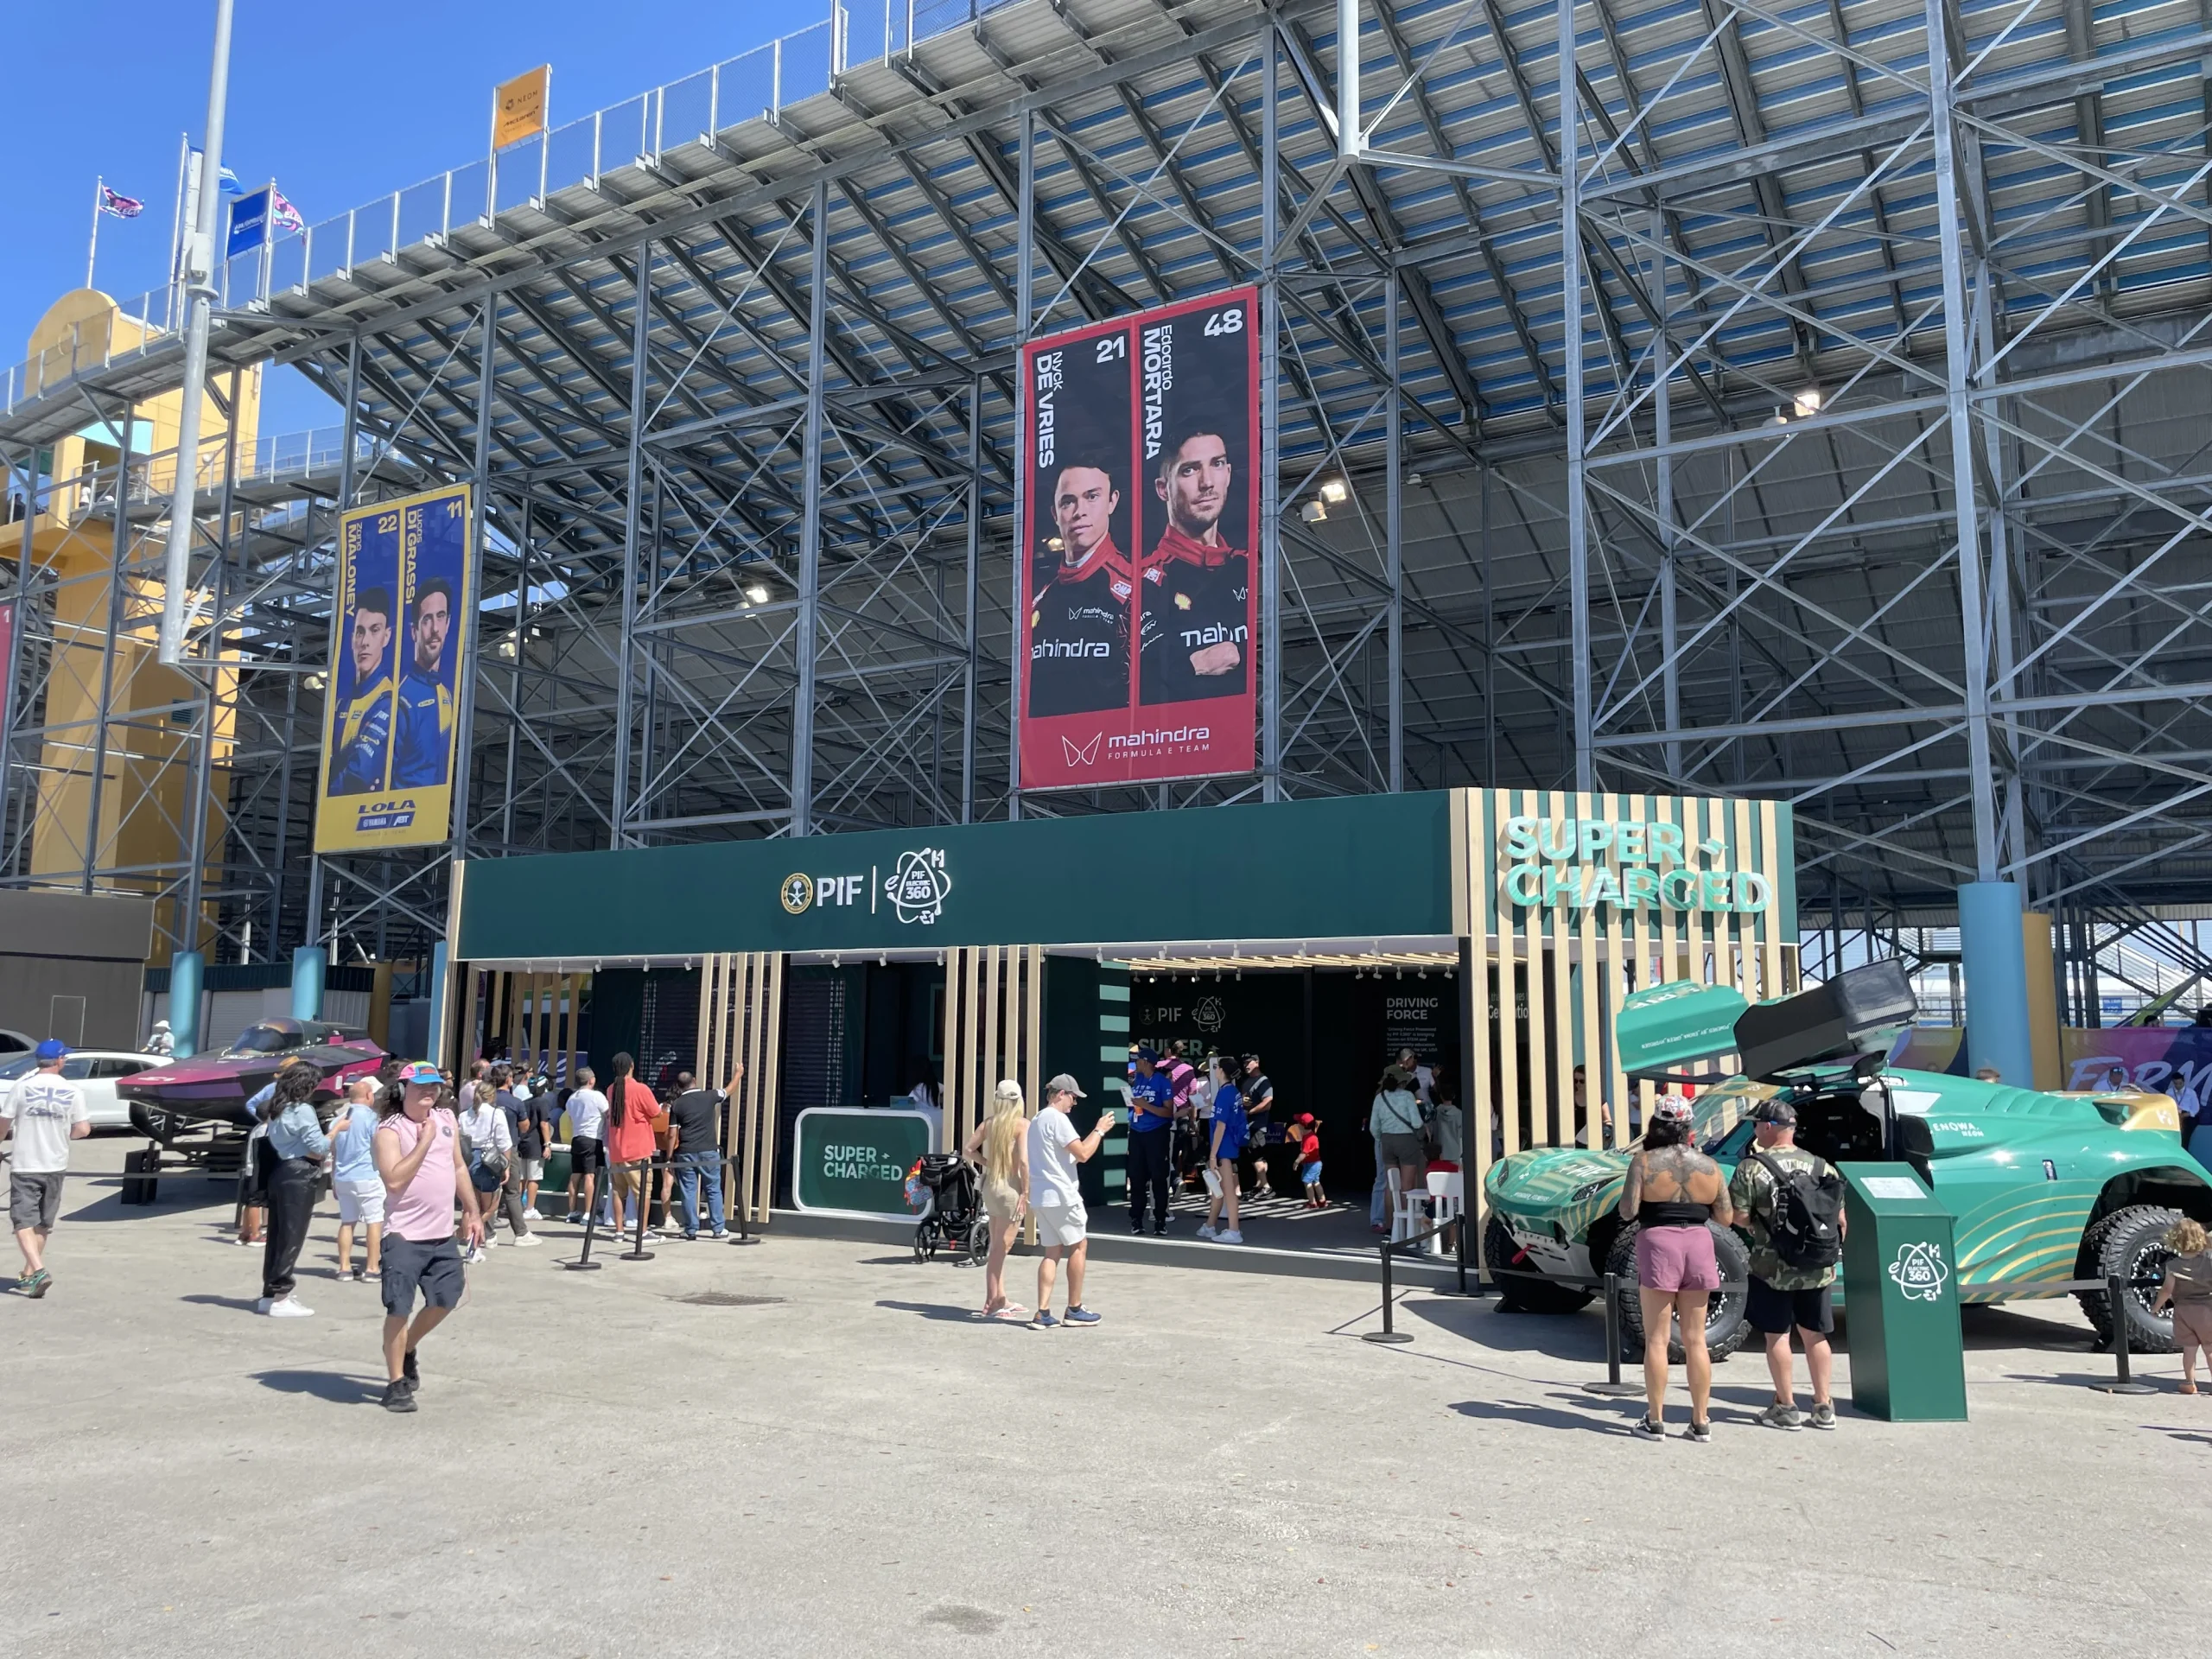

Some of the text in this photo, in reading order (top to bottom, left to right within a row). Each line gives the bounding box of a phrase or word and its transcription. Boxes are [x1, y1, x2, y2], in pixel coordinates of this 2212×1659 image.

[1205, 308, 1243, 336] 48
[1096, 335, 1125, 364] 21
[1160, 324, 1173, 391] Edoardo
[1052, 351, 1064, 391] Nyck
[1144, 327, 1162, 460] MORTARA
[1037, 354, 1054, 468] DE VRIES
[447, 500, 462, 518] 11
[378, 514, 397, 534] 22
[406, 511, 416, 605] DI GRASSI
[346, 524, 357, 617] MALONEY
[1114, 582, 1132, 595] OMP
[1109, 726, 1210, 749] mahindra
[1108, 748, 1162, 760] FORMULA
[1179, 743, 1210, 753] TEAM
[358, 799, 416, 814] LOLA
[1504, 816, 1685, 864] SUPER
[912, 871, 925, 880] PIF
[817, 875, 864, 907] PIF
[906, 886, 931, 899] 360
[1503, 863, 1772, 913] CHARGED
[1387, 997, 1438, 1007] DRIVING
[1158, 1007, 1182, 1022] PIF
[1387, 1009, 1427, 1020] FORCE
[1138, 1038, 1203, 1056] SUER
[824, 1144, 877, 1162] SUPER
[823, 1162, 903, 1181] CHARGED
[1908, 1270, 1931, 1281] 360
